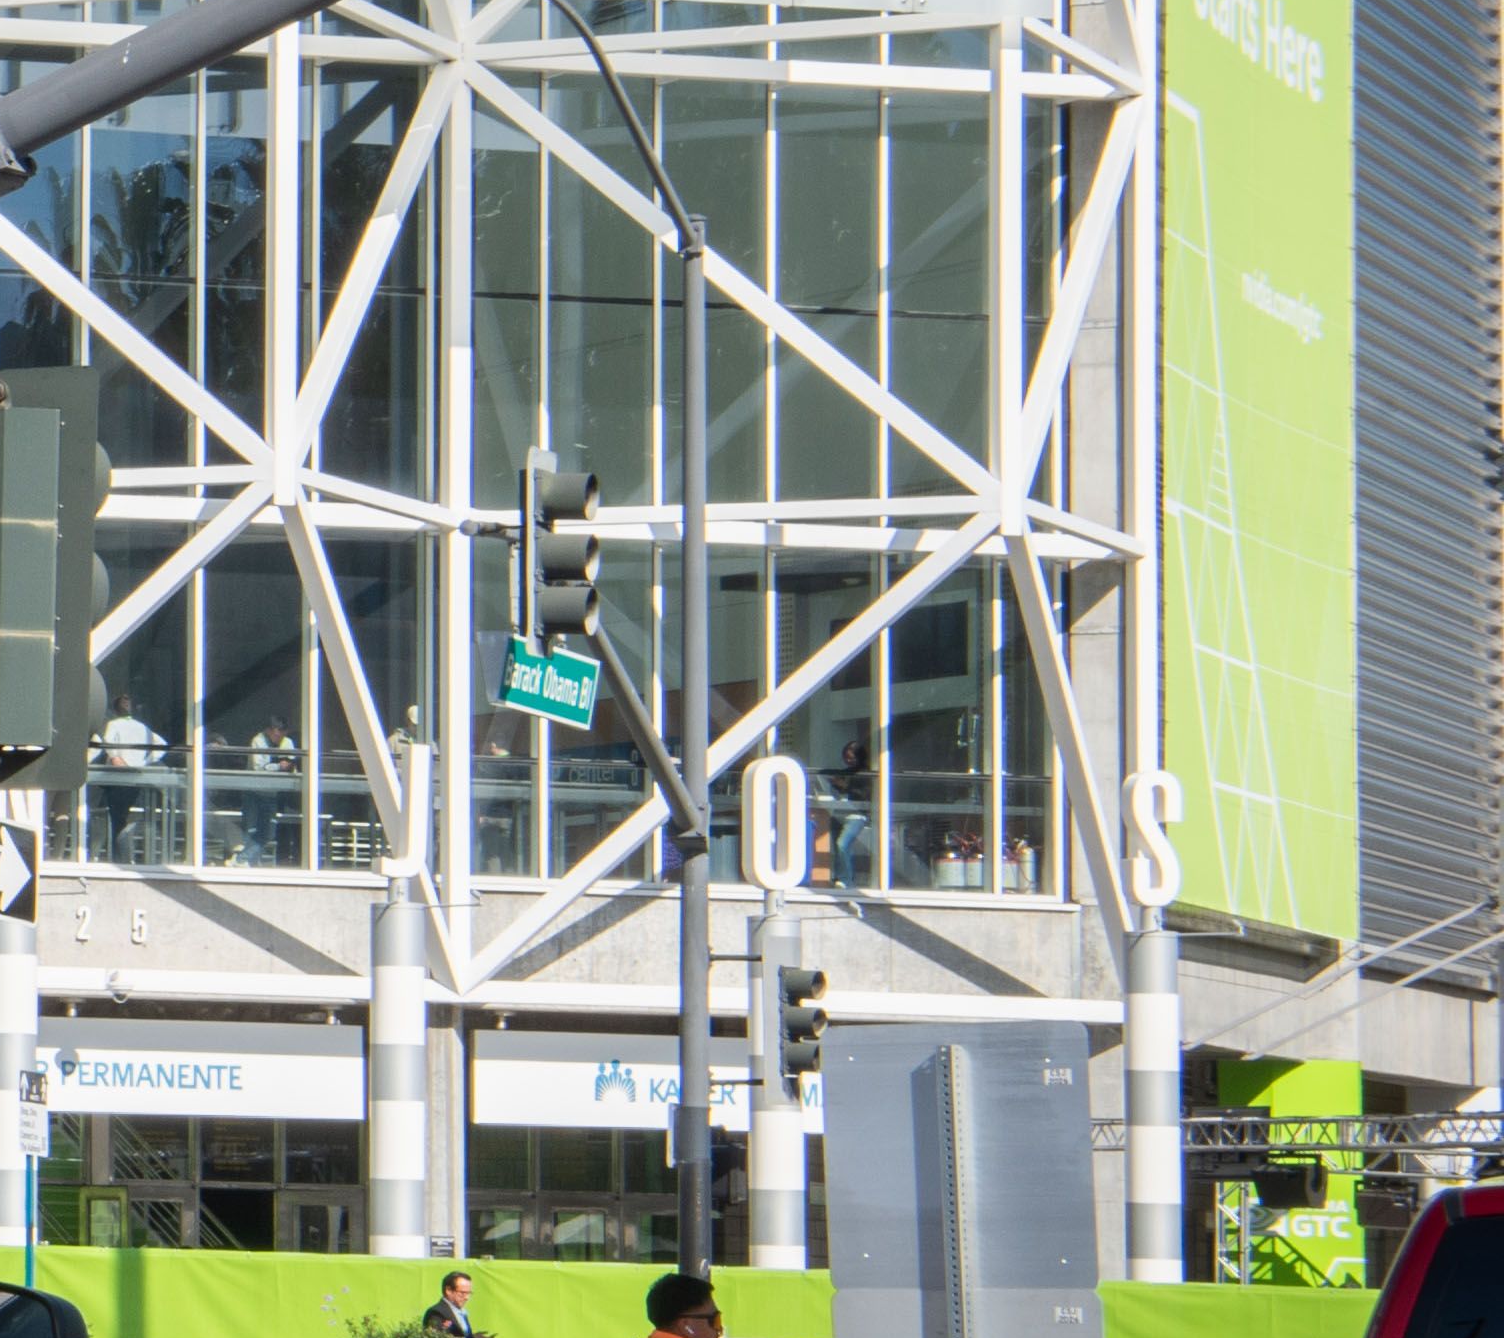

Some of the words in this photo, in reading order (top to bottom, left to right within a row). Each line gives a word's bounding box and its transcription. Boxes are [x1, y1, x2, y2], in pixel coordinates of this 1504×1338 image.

[505, 653, 543, 696] Barack
[543, 665, 579, 707] Obama
[61, 1060, 243, 1091] PERMANENTE
[1291, 1214, 1352, 1239] GTC
